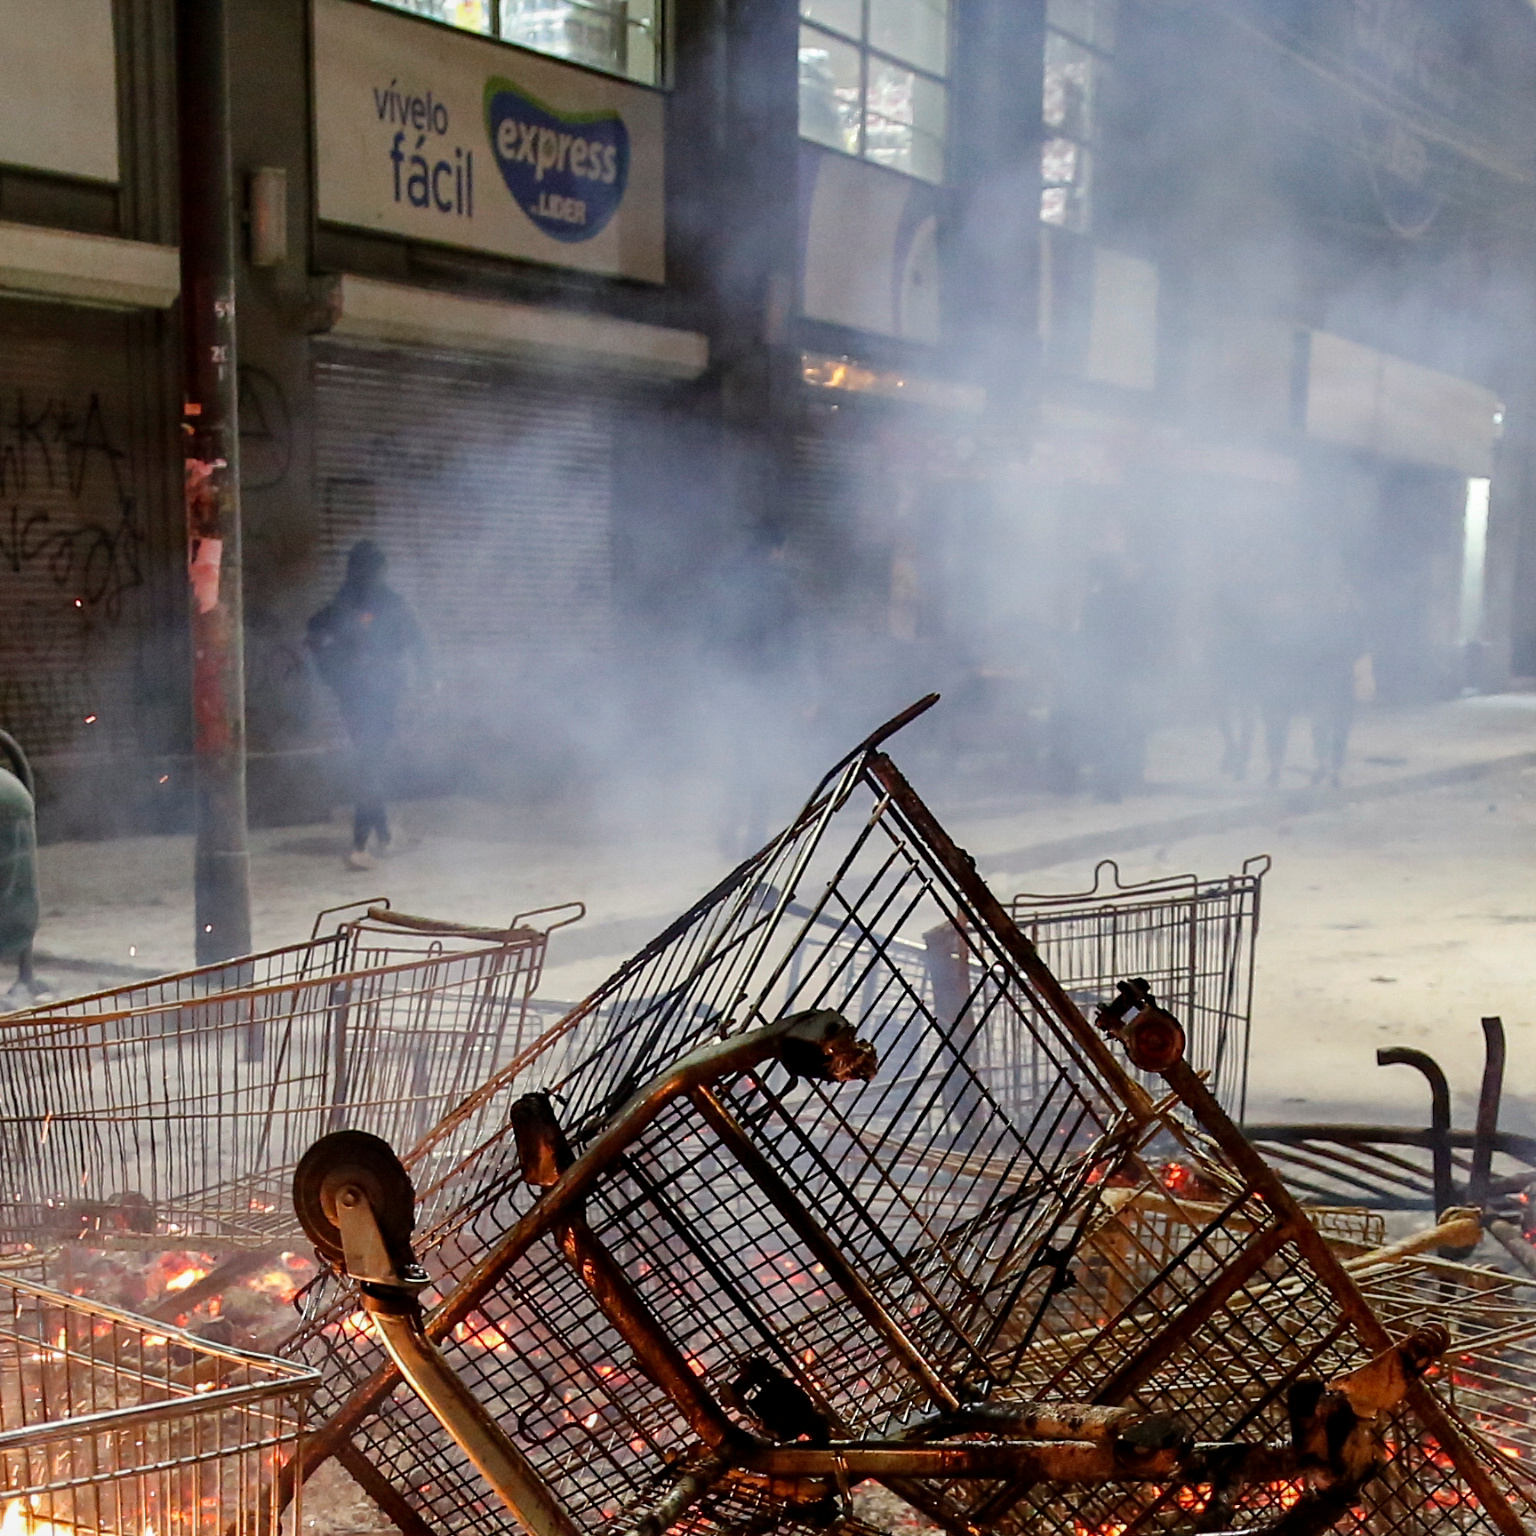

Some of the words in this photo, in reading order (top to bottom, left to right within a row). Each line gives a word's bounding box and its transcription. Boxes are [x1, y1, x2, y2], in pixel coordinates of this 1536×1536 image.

[373, 80, 449, 135] vívelo
[390, 131, 473, 218] fácil
[496, 117, 617, 185] express
